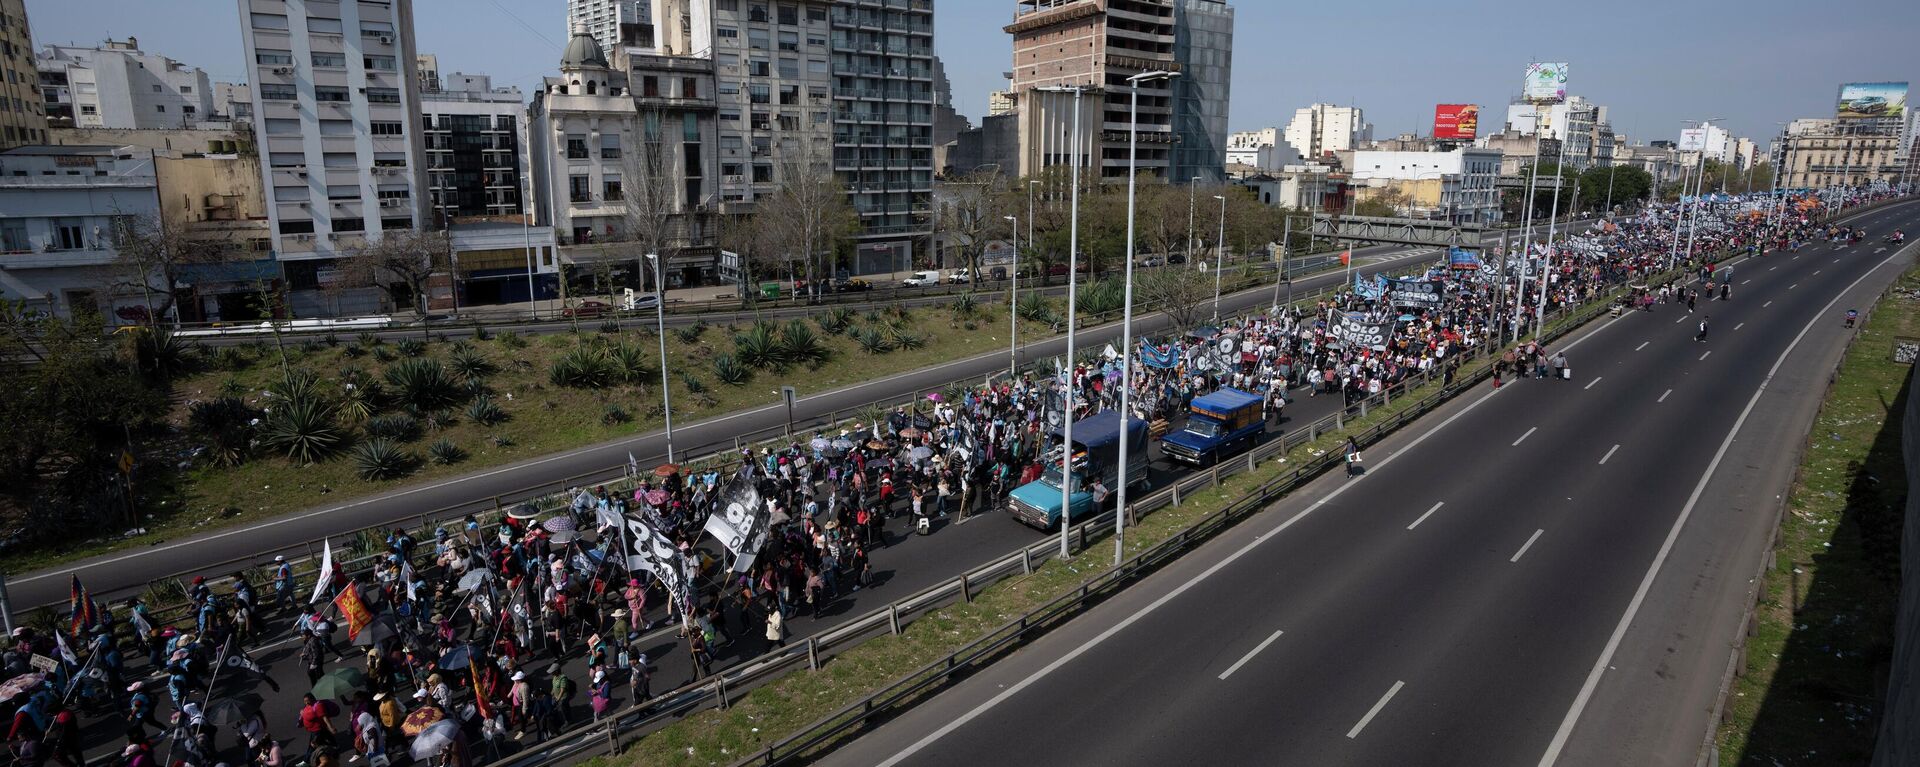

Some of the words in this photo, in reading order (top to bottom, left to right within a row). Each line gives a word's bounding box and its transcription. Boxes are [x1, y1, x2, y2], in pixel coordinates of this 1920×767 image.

[1396, 282, 1434, 294] POLO
[1390, 290, 1439, 303] OBRERO
[1341, 317, 1380, 335] POLO
